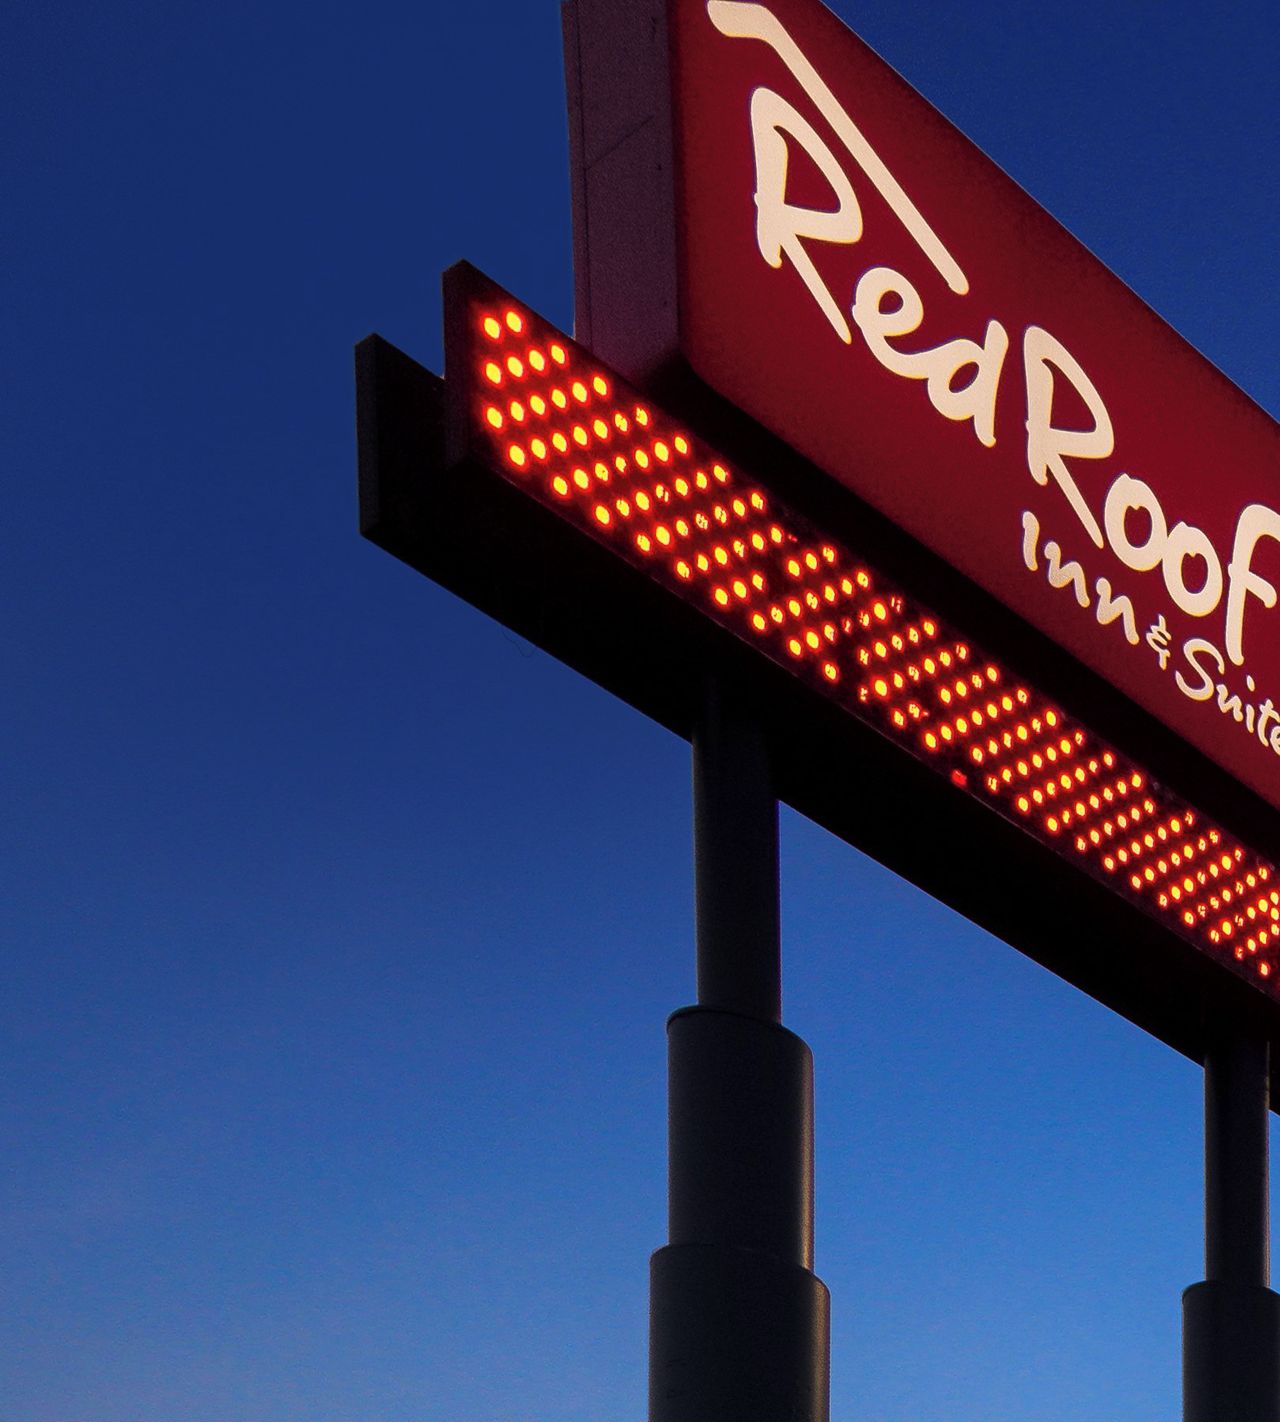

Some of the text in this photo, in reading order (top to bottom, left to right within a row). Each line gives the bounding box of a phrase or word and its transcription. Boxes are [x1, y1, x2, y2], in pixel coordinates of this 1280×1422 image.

[750, 86, 1009, 448] Red
[1021, 510, 1141, 645] Inn
[1144, 614, 1172, 671] &
